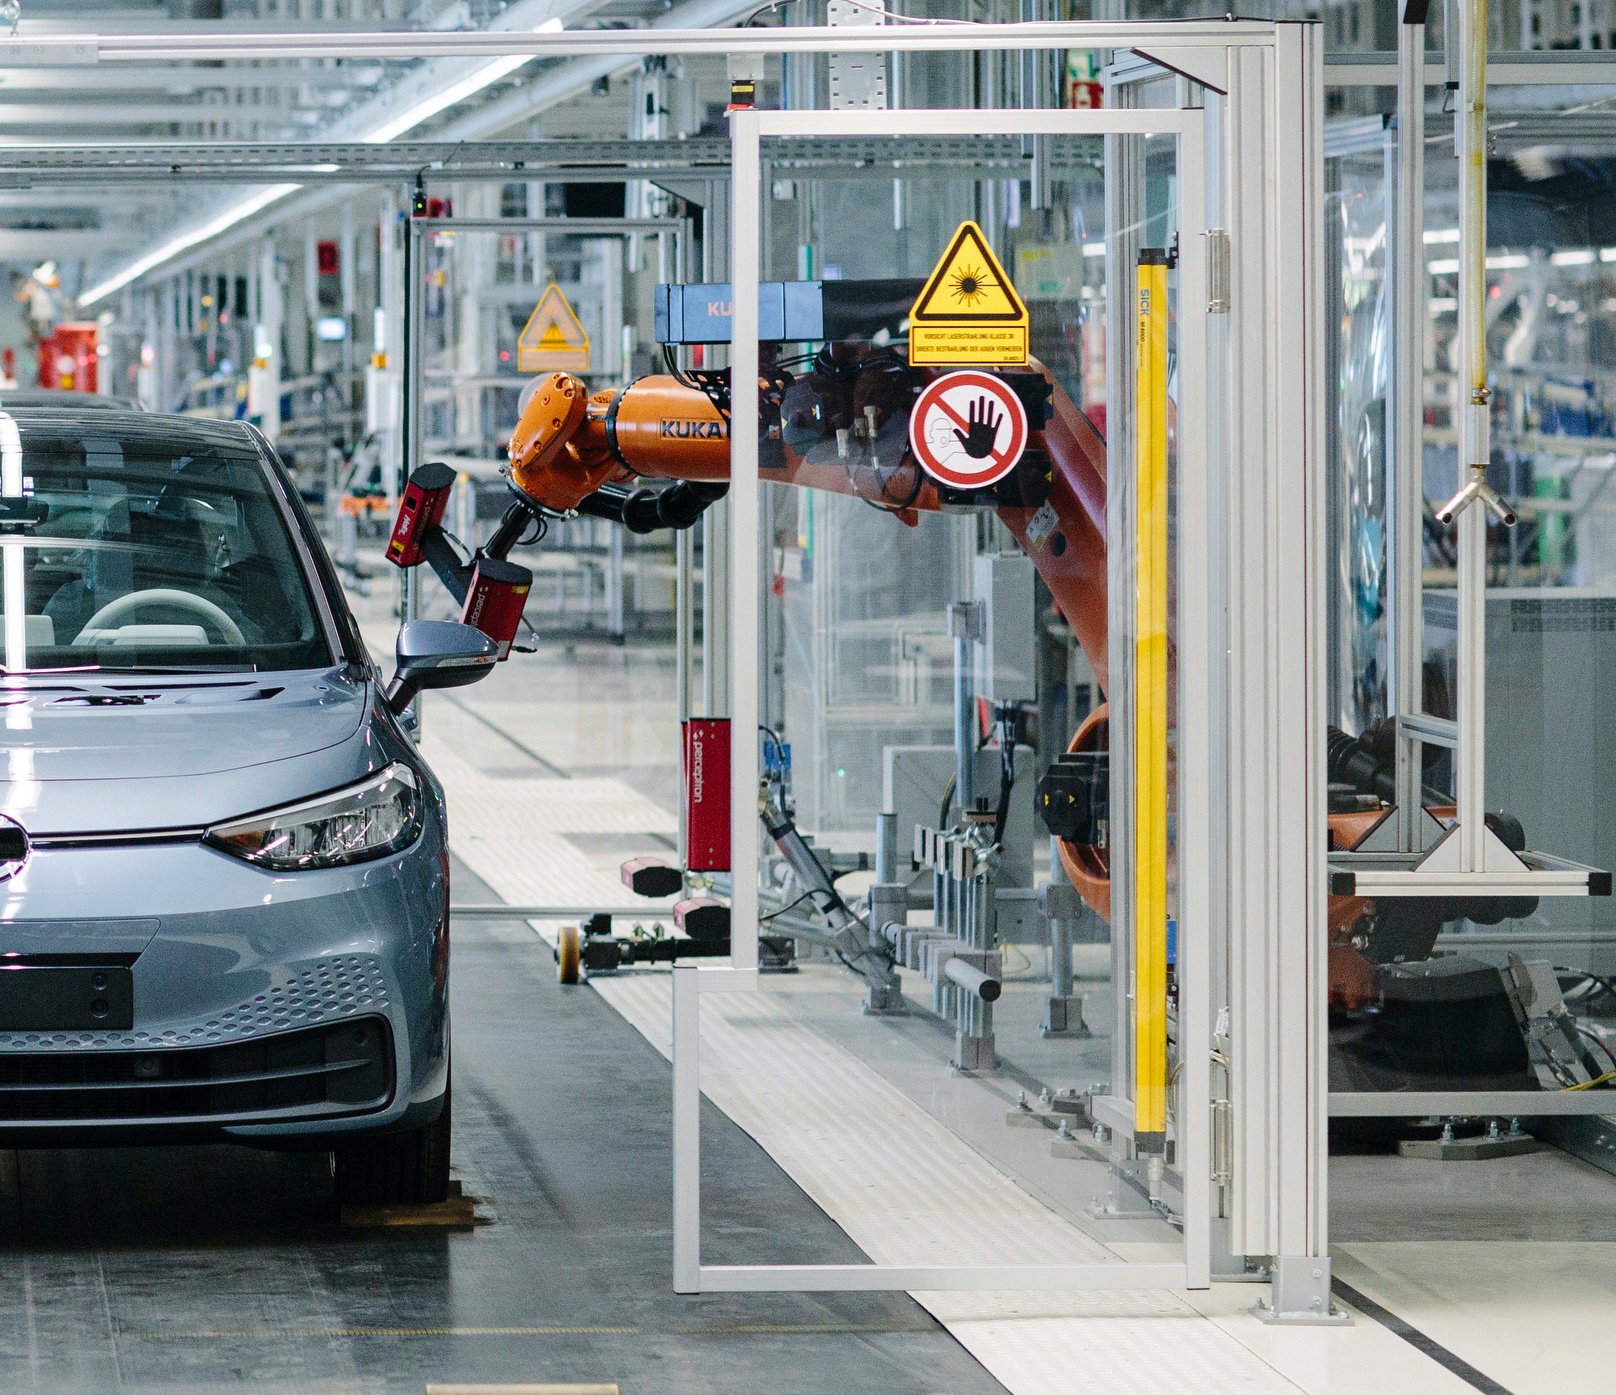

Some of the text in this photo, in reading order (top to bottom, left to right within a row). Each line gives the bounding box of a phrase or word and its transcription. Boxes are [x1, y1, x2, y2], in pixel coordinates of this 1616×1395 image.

[708, 302, 732, 317] KU
[1140, 289, 1150, 316] SICK
[662, 420, 722, 438] KUKA
[470, 593, 486, 626] percep
[693, 742, 704, 802] perceptron
